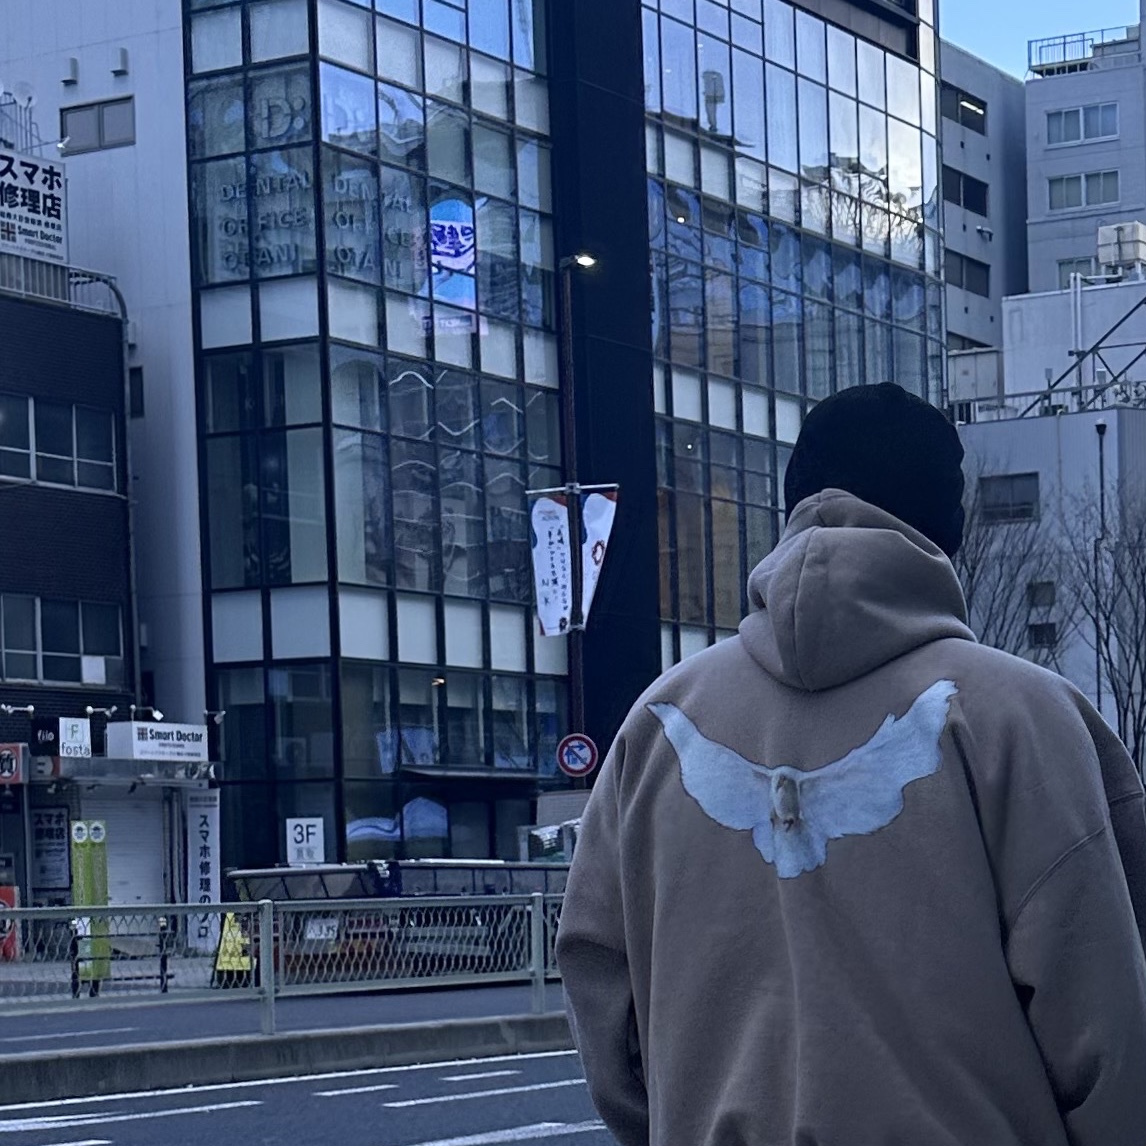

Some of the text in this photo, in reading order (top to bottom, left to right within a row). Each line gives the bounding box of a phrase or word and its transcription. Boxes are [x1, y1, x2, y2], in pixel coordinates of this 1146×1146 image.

[0, 155, 62, 190] スマホ
[0, 181, 61, 220] 修理店
[149, 728, 203, 743] Smart Doctor
[293, 824, 317, 844] 3F
